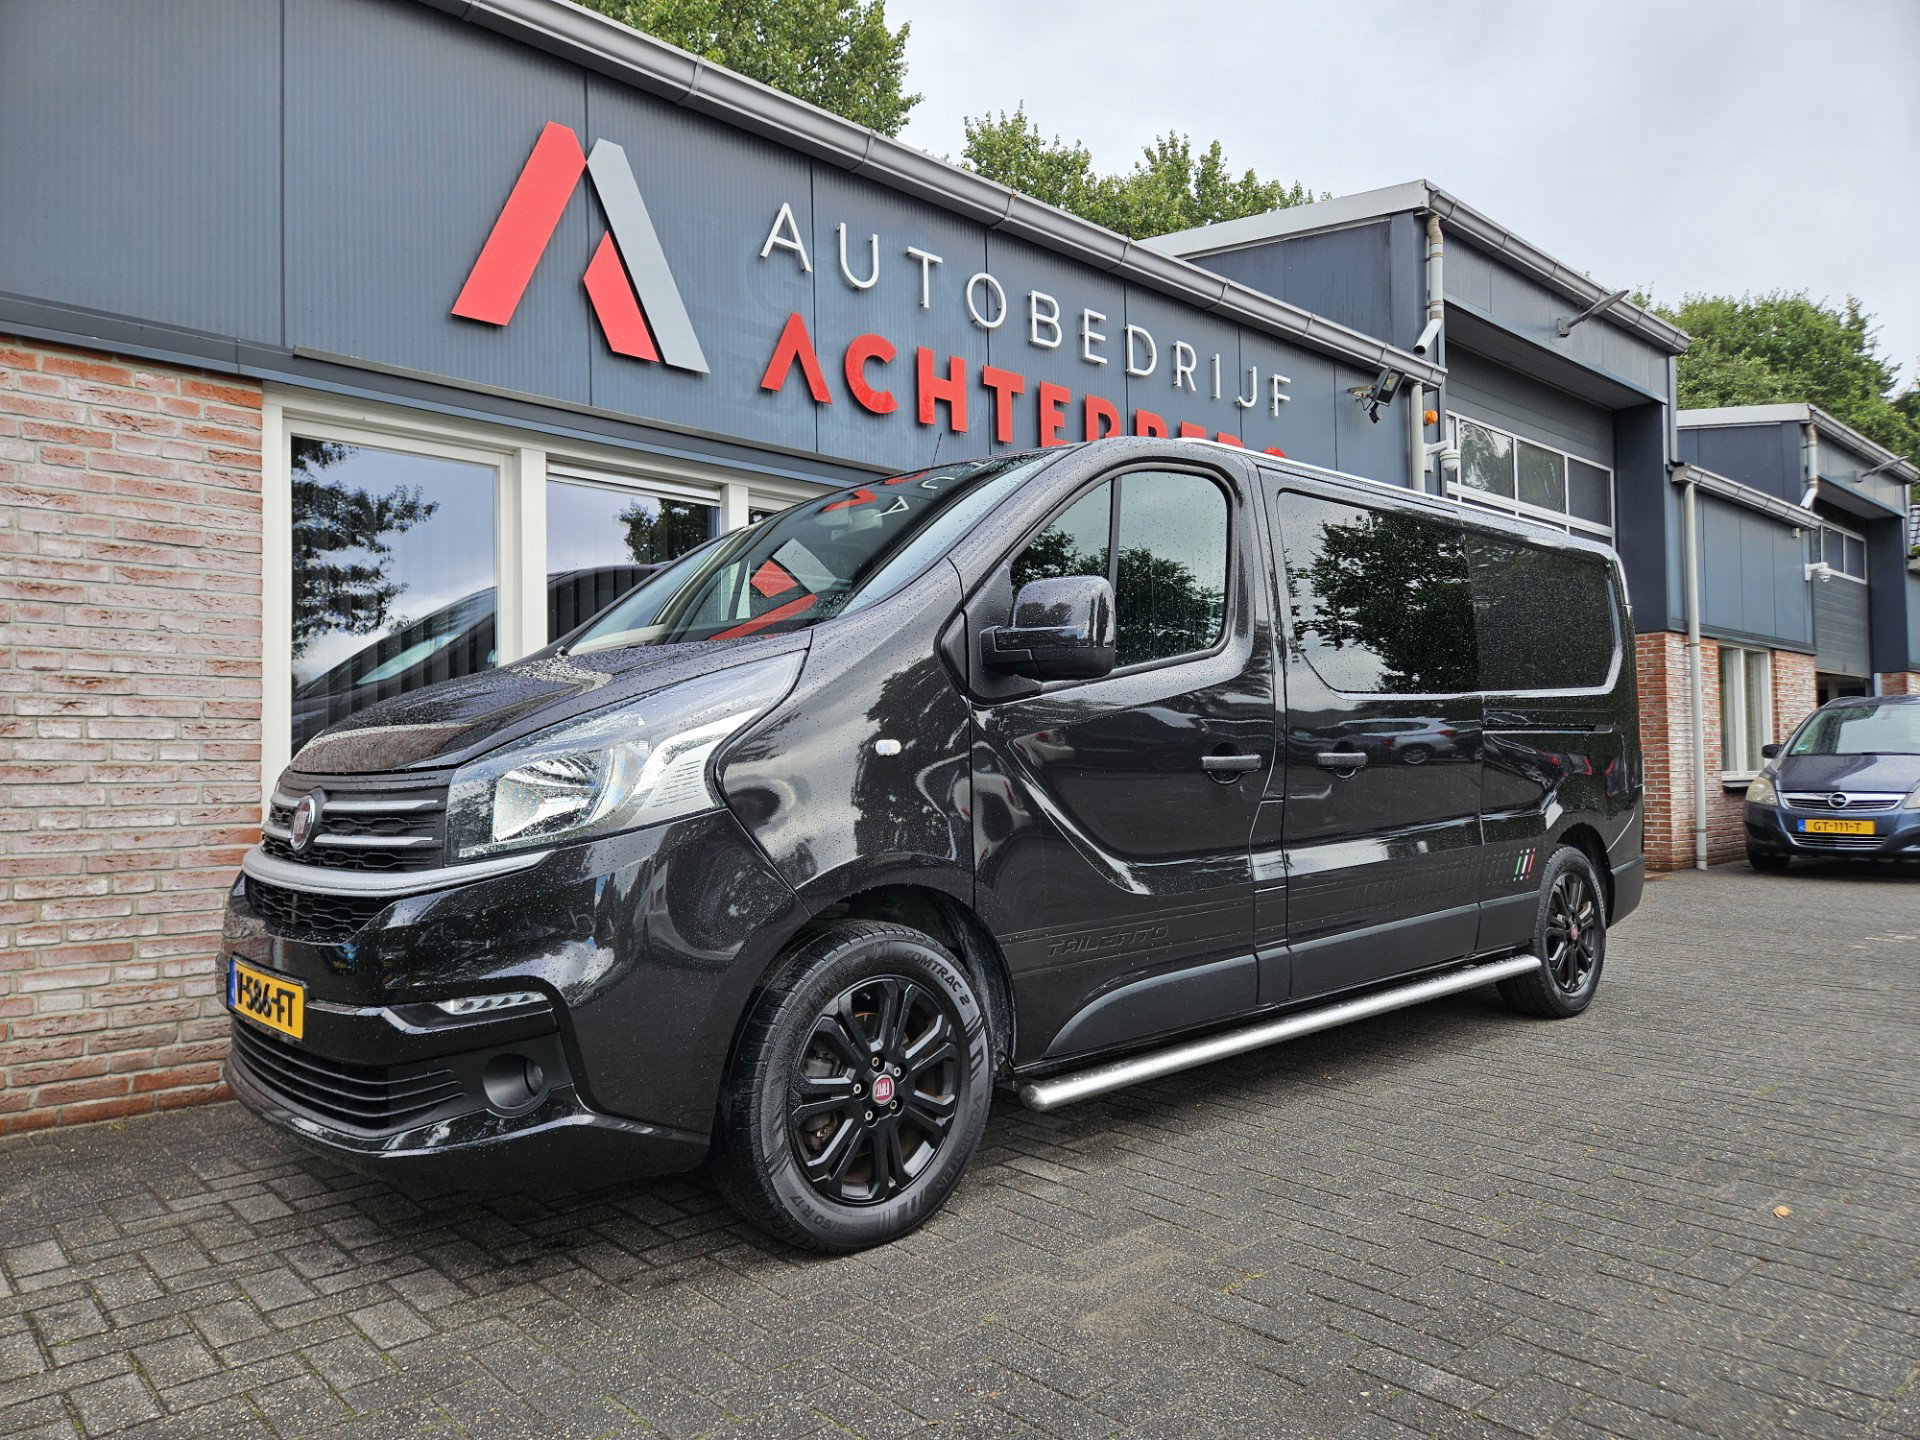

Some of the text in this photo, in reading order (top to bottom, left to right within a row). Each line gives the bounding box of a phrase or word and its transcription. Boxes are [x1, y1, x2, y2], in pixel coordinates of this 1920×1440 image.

[760, 202, 1291, 417] AUTOBEDRIJF
[760, 312, 1287, 458] ACHTER
[1813, 821, 1862, 833] GT-111-T
[236, 970, 296, 1029] V-586-FT
